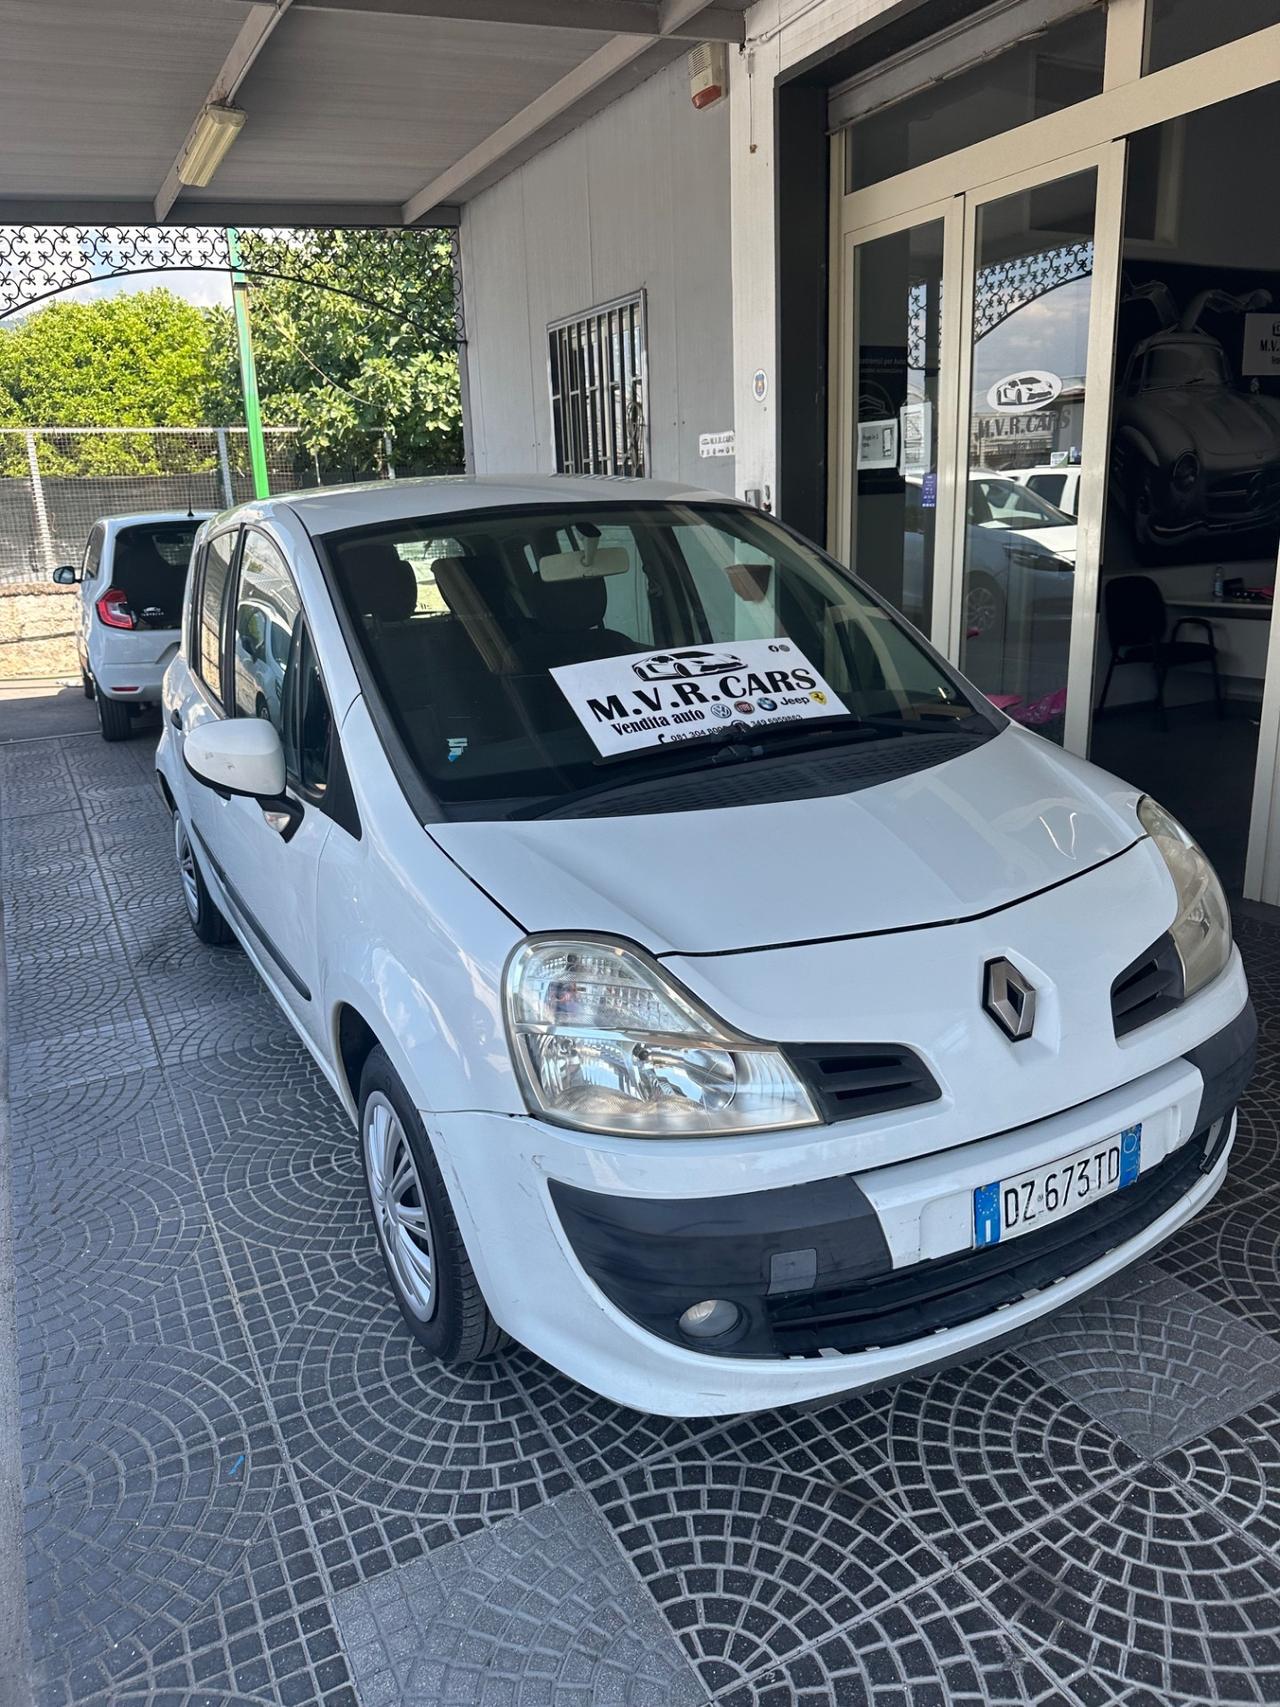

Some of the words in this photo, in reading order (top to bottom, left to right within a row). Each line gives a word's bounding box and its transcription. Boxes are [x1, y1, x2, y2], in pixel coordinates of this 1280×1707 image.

[586, 668, 817, 722] M.V.R.CARS
[780, 697, 810, 706] Jeep
[611, 715, 670, 736] Vendita
[672, 708, 705, 724] auto
